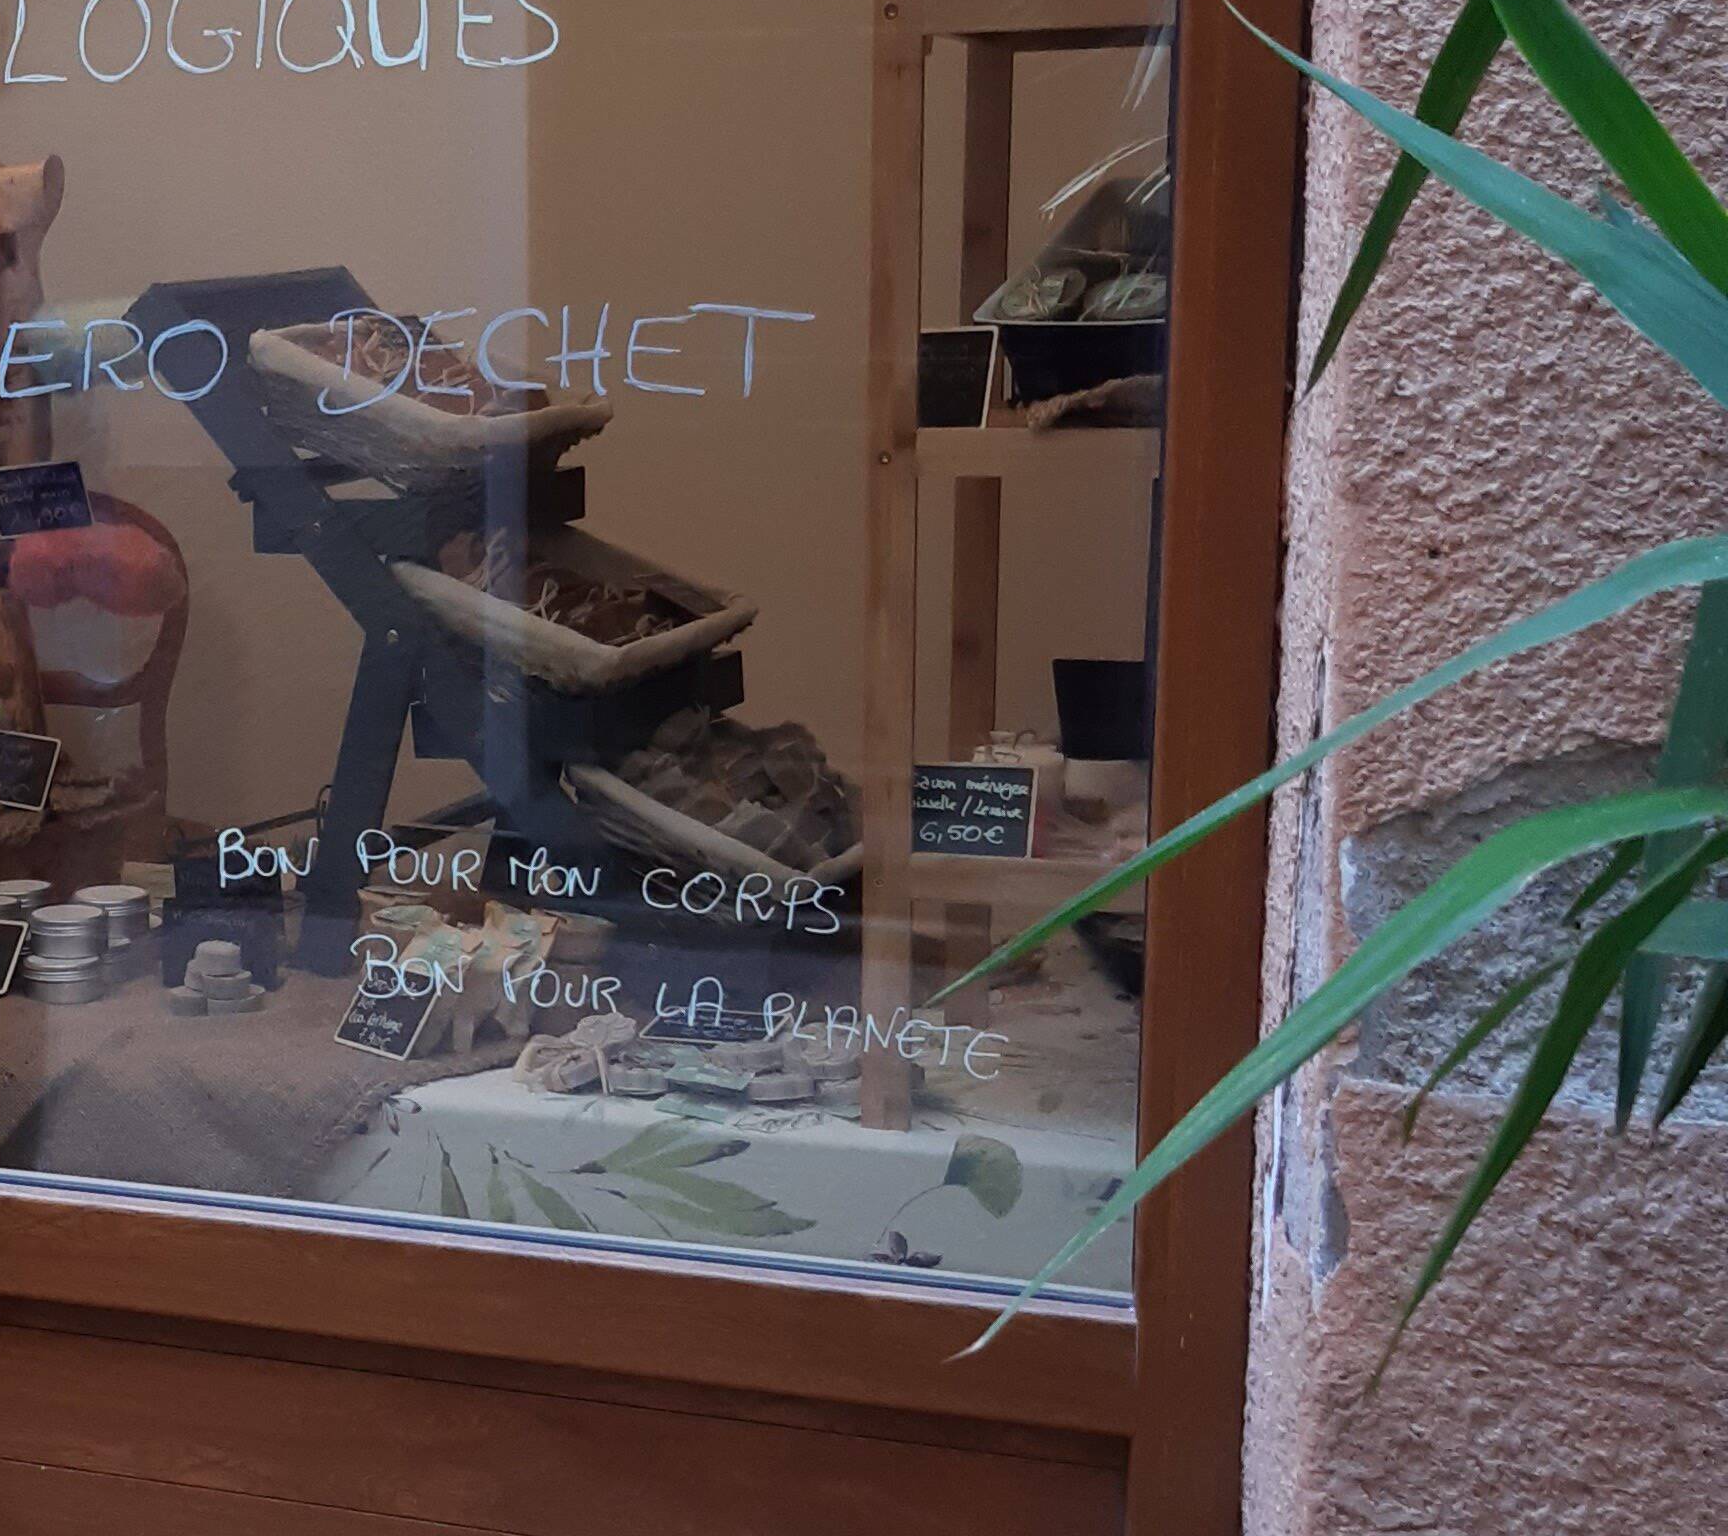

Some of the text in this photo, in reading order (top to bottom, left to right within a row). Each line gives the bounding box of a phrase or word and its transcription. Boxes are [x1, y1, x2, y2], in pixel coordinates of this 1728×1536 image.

[318, 301, 816, 417] DECHET
[913, 794, 957, 811] isselle
[919, 821, 1005, 844] 6,50€
[217, 827, 845, 935] BON POUR MON CORPS
[350, 934, 471, 999] BON
[503, 952, 622, 1013] POUR
[656, 976, 724, 1027] LA
[763, 992, 1009, 1081] PLANETE
